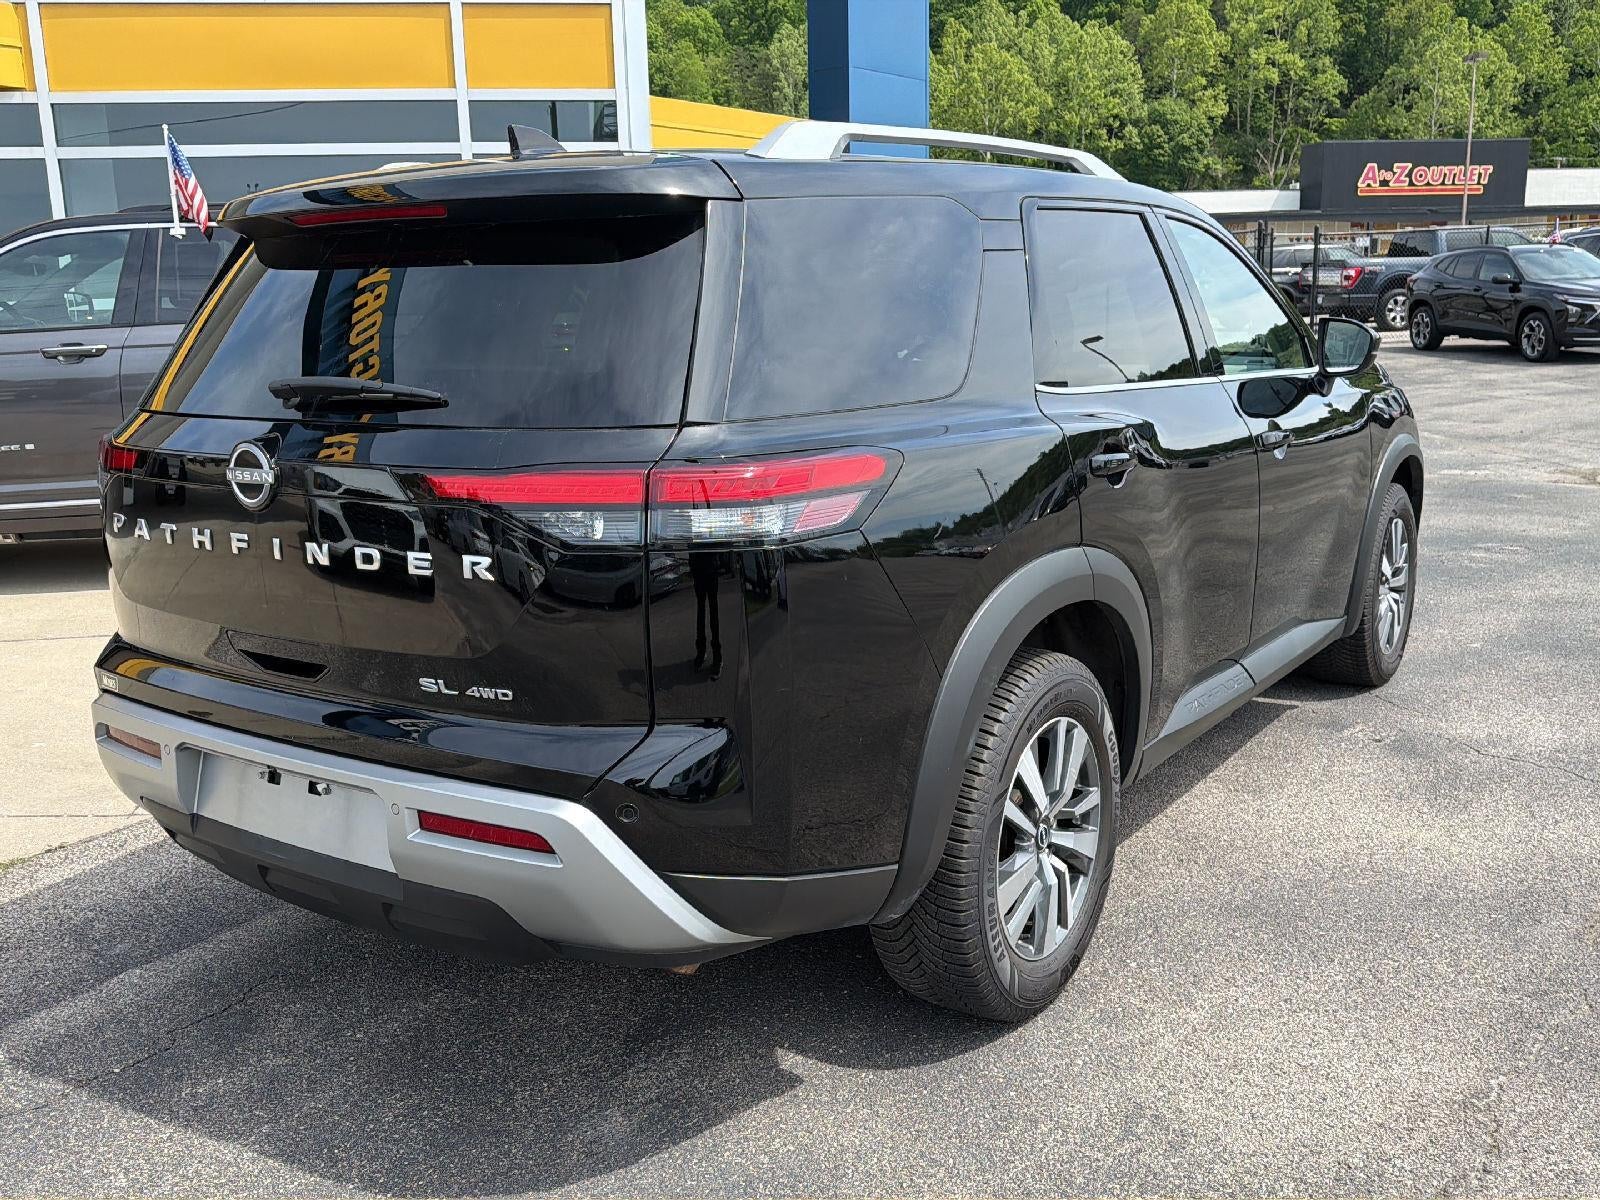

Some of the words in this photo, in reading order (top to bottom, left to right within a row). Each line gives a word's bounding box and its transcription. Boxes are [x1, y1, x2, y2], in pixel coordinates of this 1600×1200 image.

[1411, 165, 1493, 186] OUTLET
[226, 469, 273, 483] NISSAN
[112, 512, 496, 581] PATHFINDER
[419, 678, 459, 695] SL
[465, 686, 513, 701] 4WD
